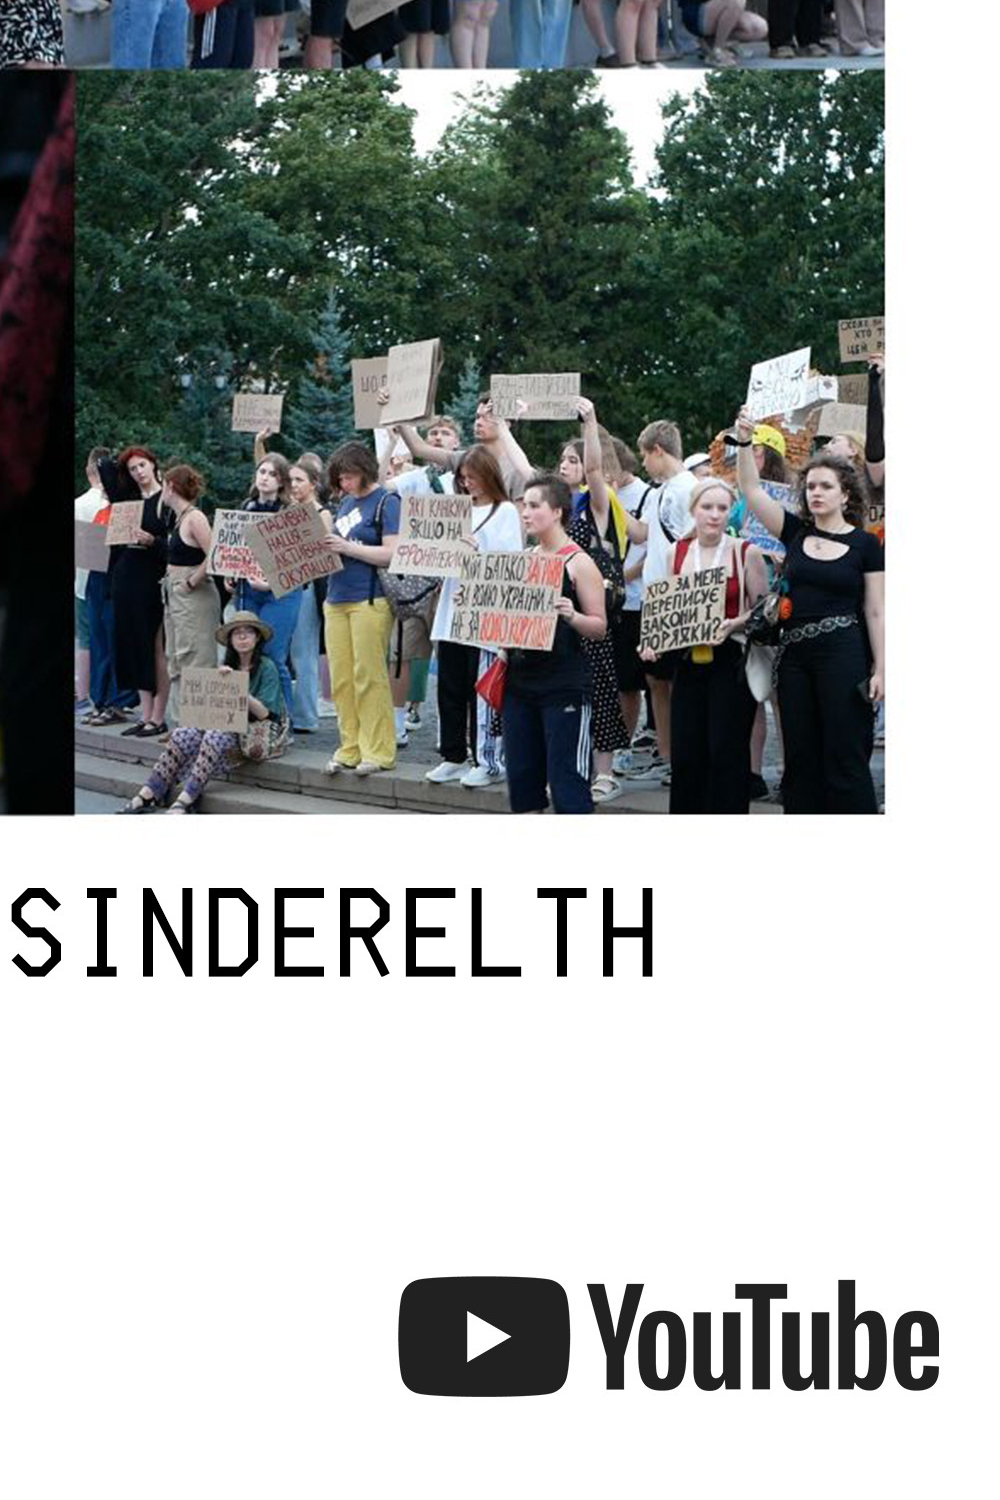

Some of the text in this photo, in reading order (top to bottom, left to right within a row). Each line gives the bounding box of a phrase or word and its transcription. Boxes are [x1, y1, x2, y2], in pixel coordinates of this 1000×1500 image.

[256, 508, 311, 537] ПАСИВНА
[409, 518, 463, 540] ЯКЩО НА
[279, 554, 337, 590] ОКУПАЦІЯ
[484, 553, 526, 582] БАТЬКО
[647, 580, 669, 598] ХТО
[675, 576, 690, 592] ЗА
[643, 587, 720, 620] ПЕРЕПИСУЄ
[641, 607, 699, 636] ЗАКОНИ
